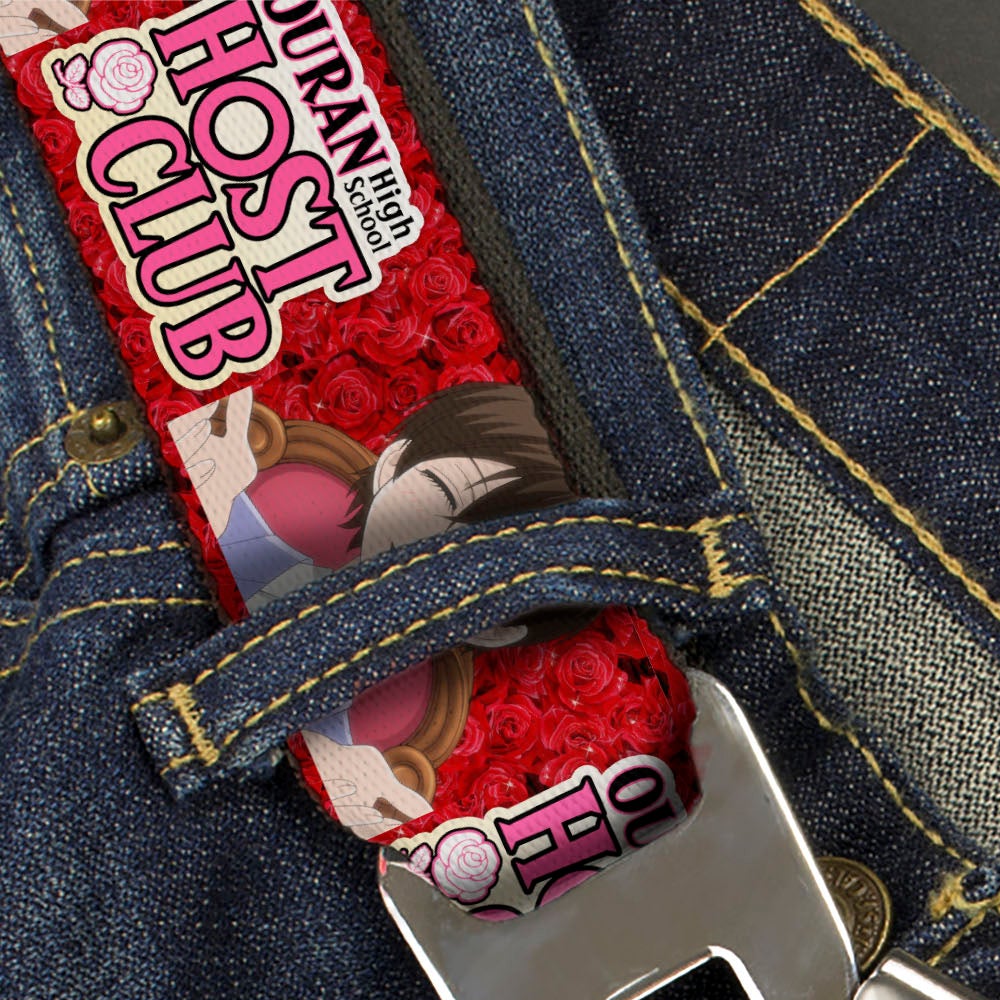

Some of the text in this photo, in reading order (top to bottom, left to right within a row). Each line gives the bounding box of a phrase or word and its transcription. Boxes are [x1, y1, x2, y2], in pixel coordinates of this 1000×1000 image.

[149, 0, 372, 303] HOST
[344, 176, 392, 254] School
[368, 167, 414, 241] High
[86, 115, 273, 381] CLUB
